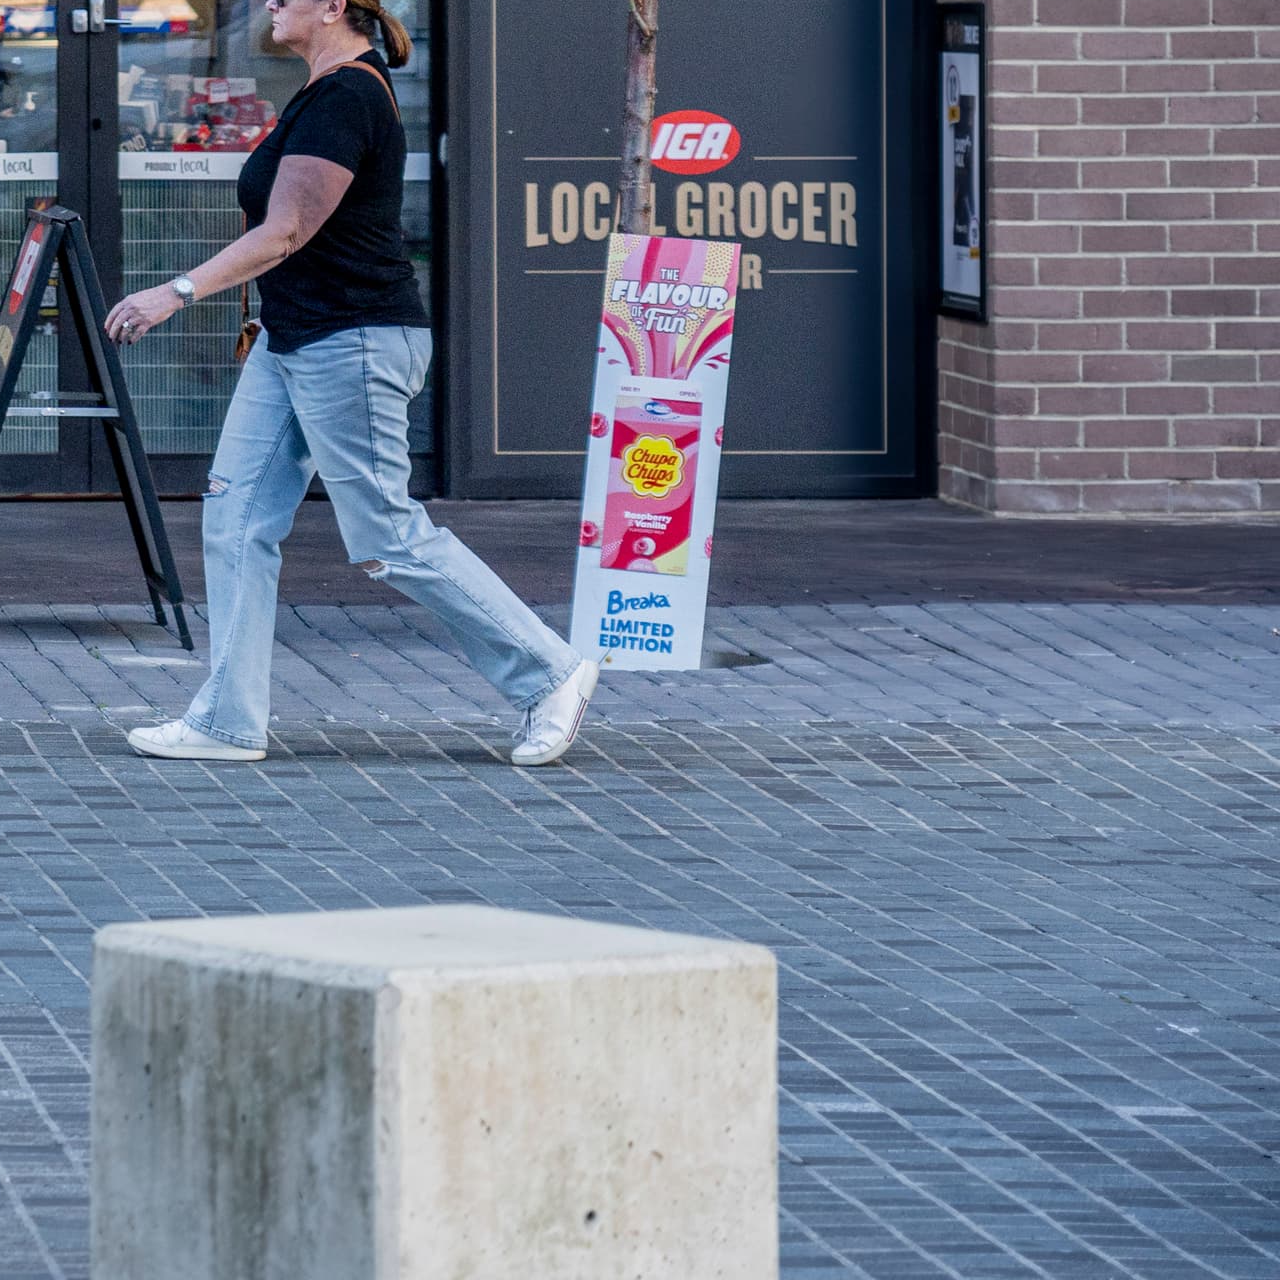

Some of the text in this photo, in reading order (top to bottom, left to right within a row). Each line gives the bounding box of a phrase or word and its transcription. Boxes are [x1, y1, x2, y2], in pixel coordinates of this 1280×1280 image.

[650, 122, 732, 160] IGA
[3, 158, 34, 174] local
[145, 157, 210, 174] PROUDLY local
[525, 181, 858, 248] LOCL GROCER
[660, 268, 680, 281] THE
[611, 280, 729, 311] FLAVOUR
[631, 305, 687, 334] OF Fun
[631, 448, 679, 469] Chupa
[627, 463, 675, 484] Chups
[624, 511, 673, 525] Raspberry
[634, 519, 668, 531] Vanilla
[606, 590, 672, 616] Breaka
[600, 617, 675, 638] LIMITED
[598, 633, 673, 654] EDITION
